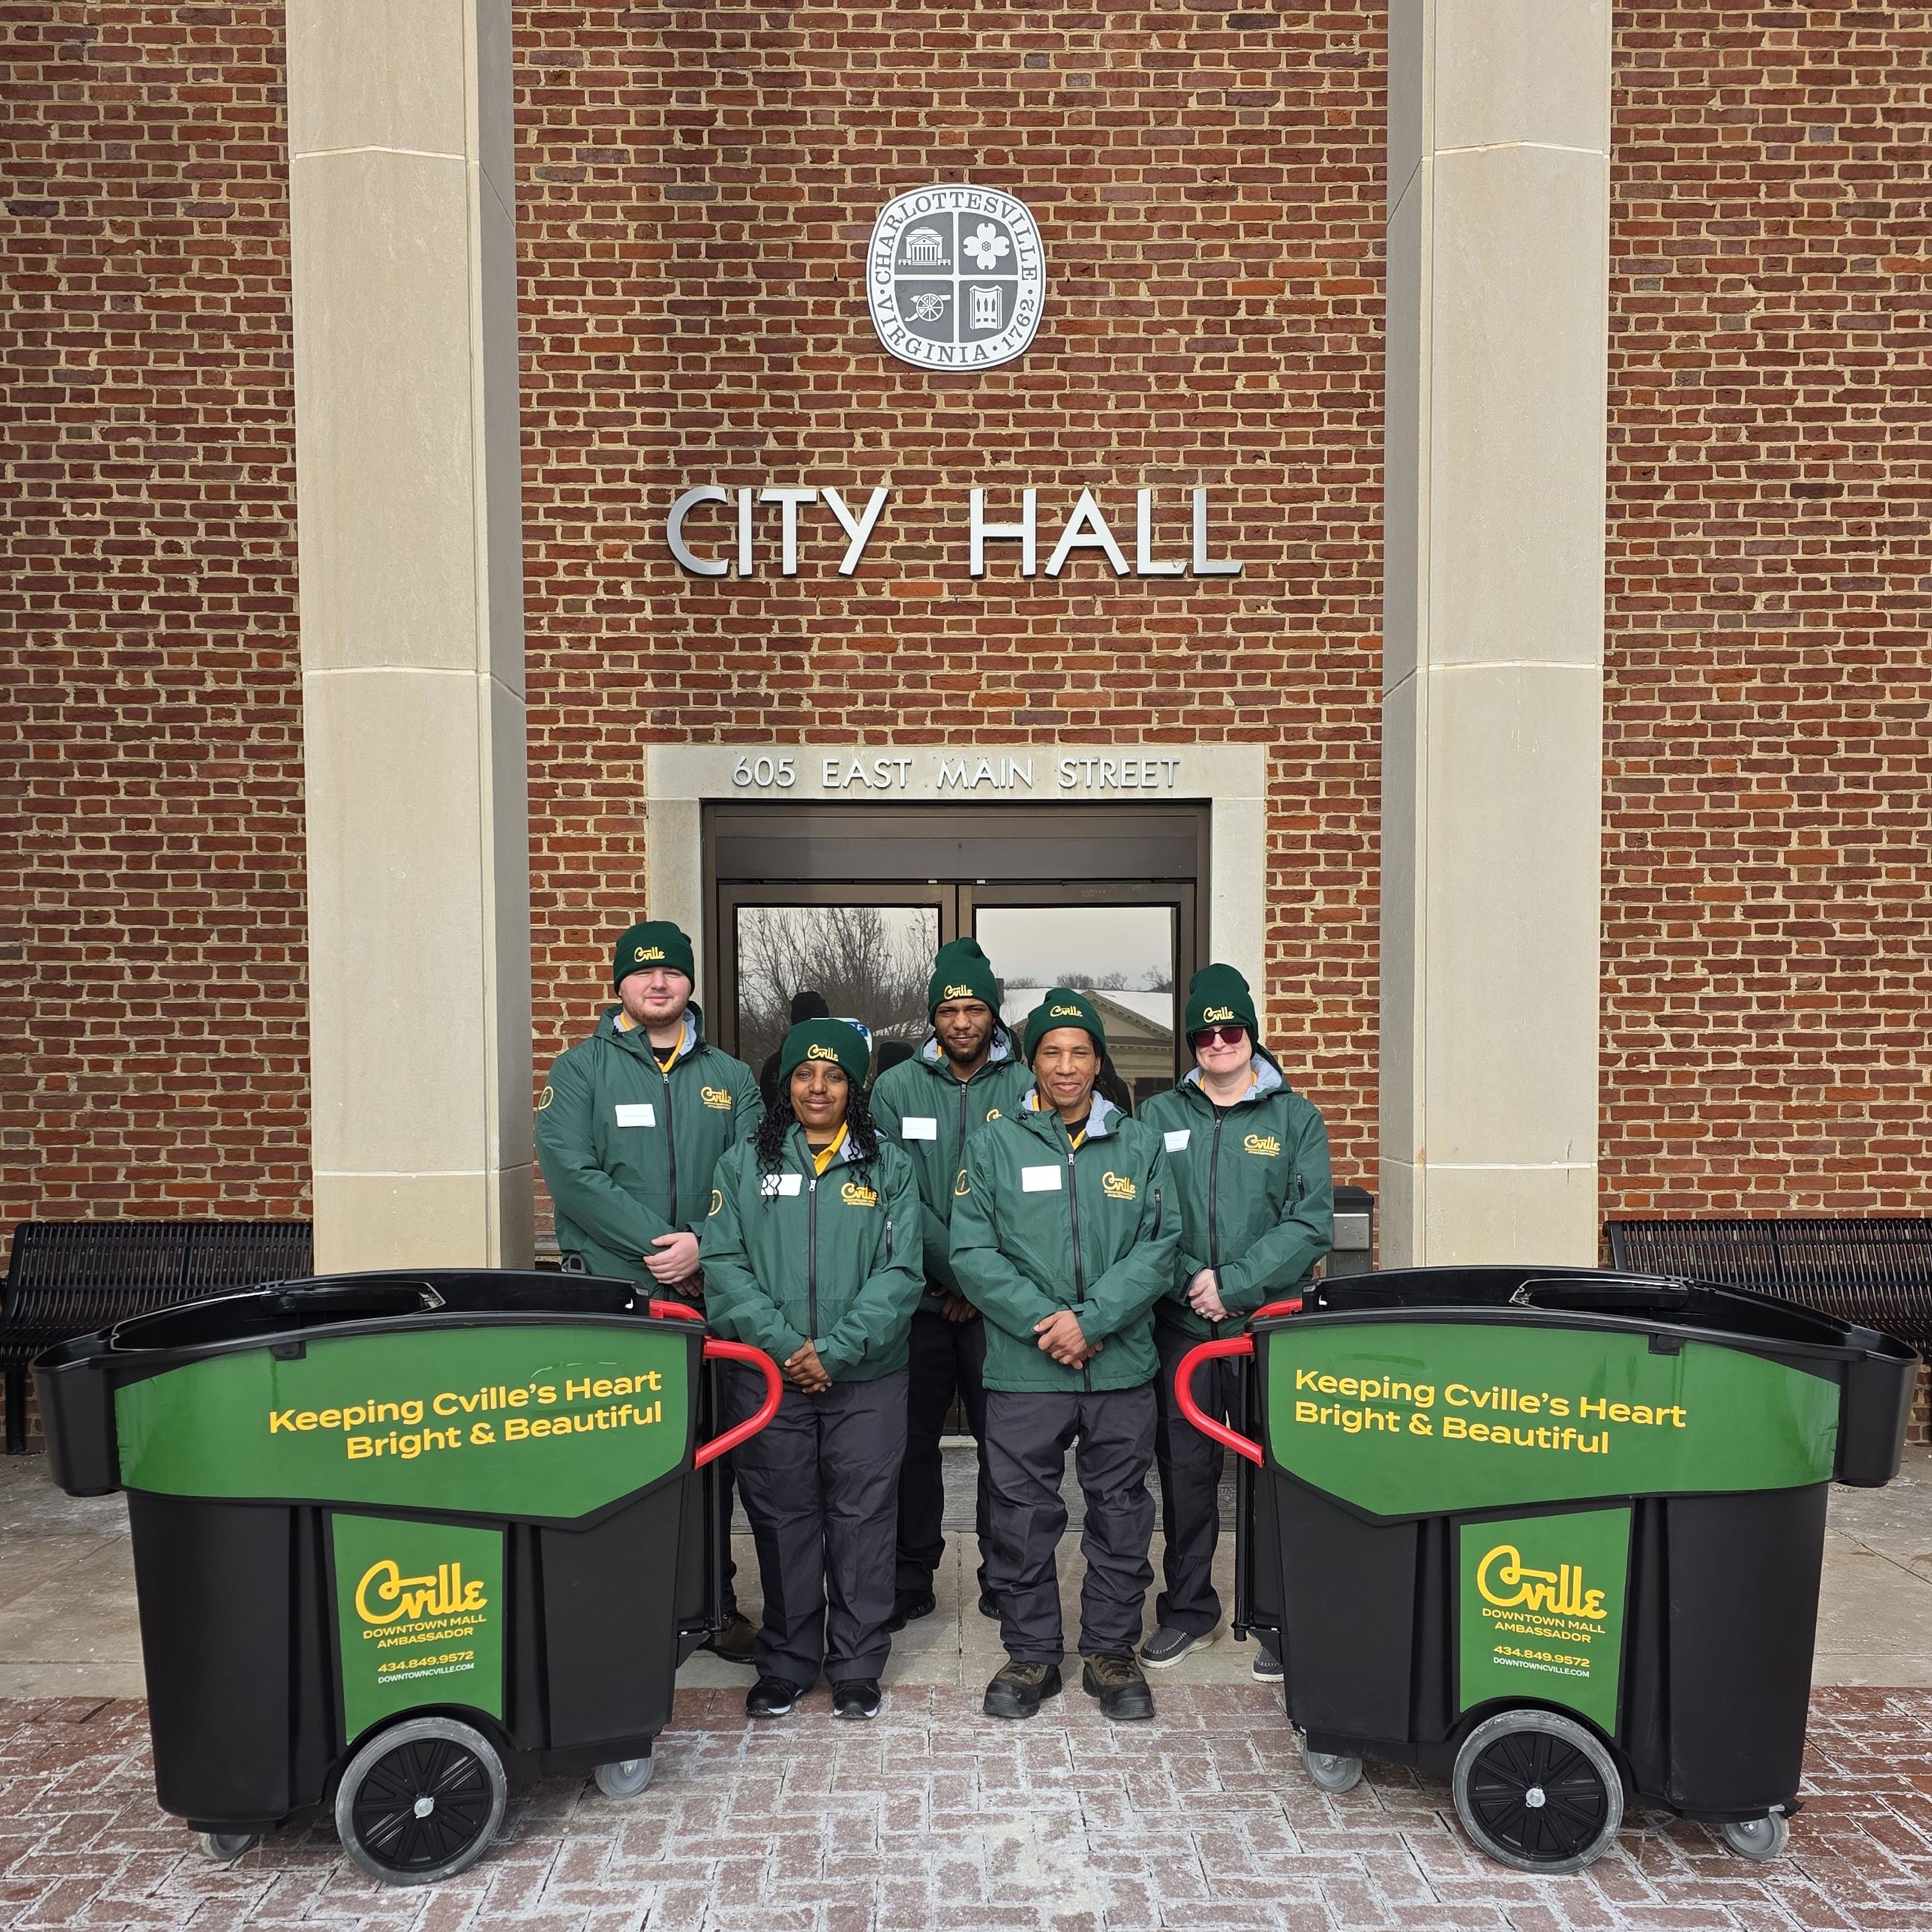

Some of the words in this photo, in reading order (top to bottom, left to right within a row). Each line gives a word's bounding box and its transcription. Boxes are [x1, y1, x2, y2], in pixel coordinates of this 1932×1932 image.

[875, 191, 1037, 285] CHARLOTTESVILLE
[877, 294, 990, 363] VIRGINIA
[1001, 298, 1036, 351] 1762
[666, 485, 889, 577] CITY
[970, 487, 1244, 577] HALL
[731, 756, 796, 788] 605
[822, 756, 912, 790] EAST
[936, 756, 1034, 790] MAIN
[1059, 756, 1180, 790] STREET
[634, 946, 666, 962] Cville
[944, 985, 973, 999] Cville
[1204, 1006, 1235, 1023] Cville
[807, 1043, 839, 1062] Cville
[1244, 1134, 1280, 1152] Cville
[1102, 1171, 1136, 1194] Cville
[269, 1399, 424, 1433] Keeping
[432, 1383, 557, 1416] Cville's
[565, 1370, 662, 1401] Heart
[1295, 1369, 1436, 1408] Keeping
[1444, 1383, 1570, 1417] Cville's
[1580, 1396, 1687, 1428] Heart
[346, 1427, 462, 1459] Bright
[470, 1422, 496, 1445] &
[505, 1401, 662, 1442] Beautiful
[1295, 1401, 1401, 1433] Bright
[1408, 1413, 1433, 1436] &
[1442, 1416, 1609, 1454] Beautiful
[355, 1559, 488, 1624] Cville
[1476, 1544, 1608, 1620] Cville
[363, 1618, 447, 1639] DOWNTOWN
[450, 1614, 487, 1627] MALL
[1482, 1607, 1565, 1628] DOWNTOWN
[1568, 1620, 1606, 1634] MALL
[1494, 1621, 1591, 1644] AMBASSADOR
[377, 1627, 474, 1649] AMBASSADOR
[377, 1650, 474, 1673] 434.849.9572
[1493, 1656, 1590, 1678] DOWNTOWNCVILLE.COM
[1494, 1645, 1590, 1667] 434.849.9572
[377, 1662, 475, 1684] DOWNTOWNCVILLE.COM
